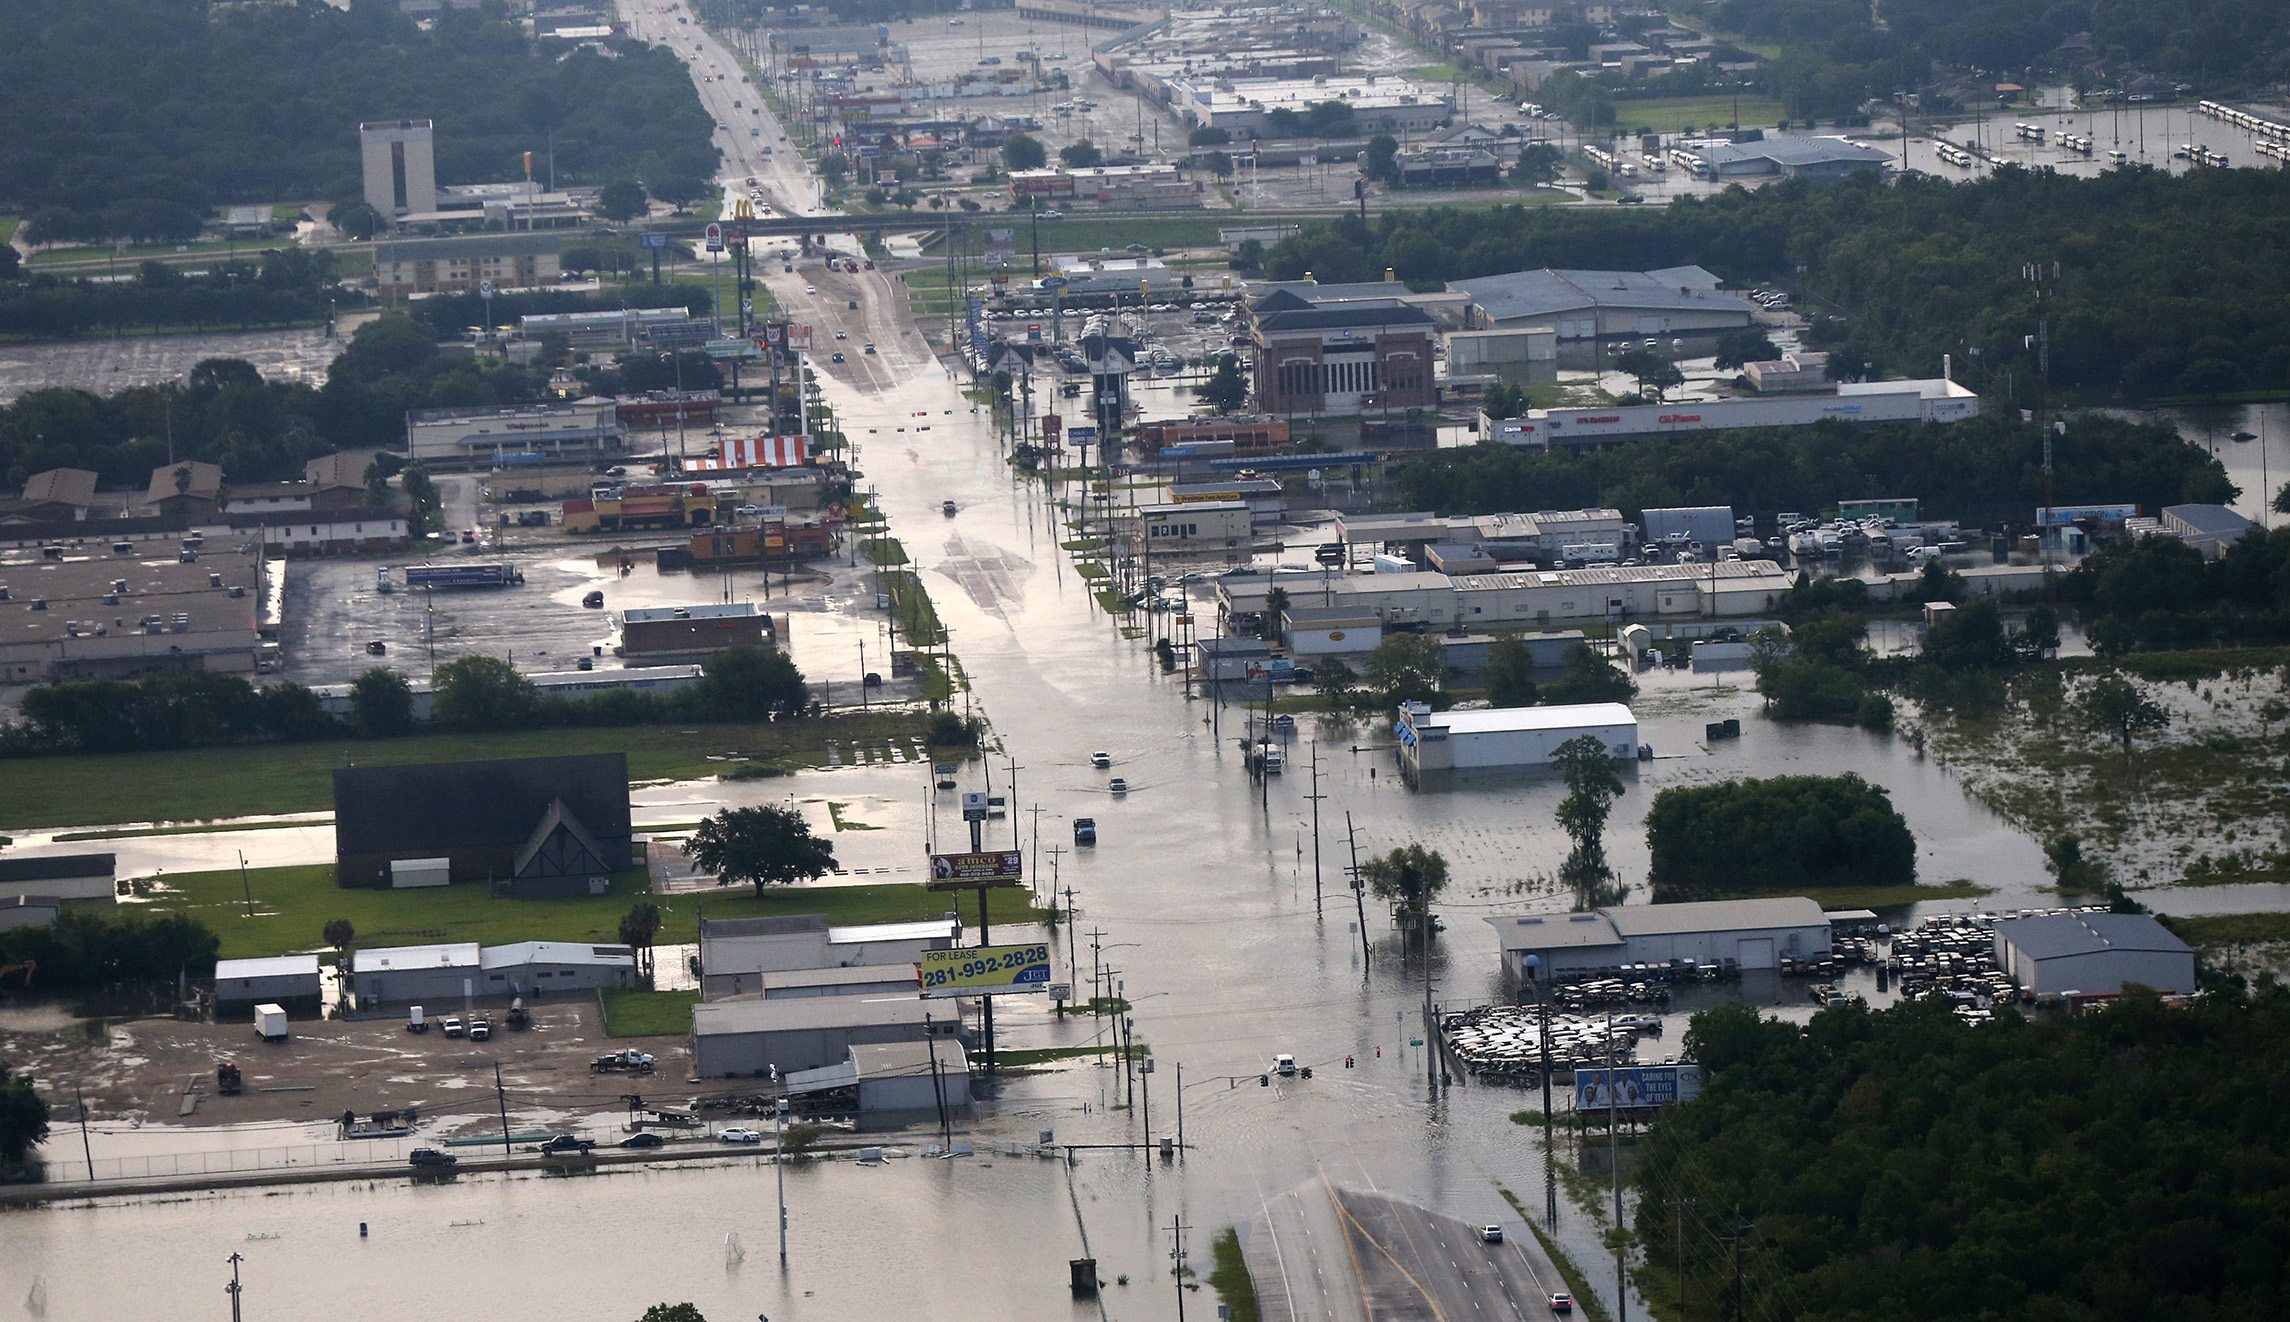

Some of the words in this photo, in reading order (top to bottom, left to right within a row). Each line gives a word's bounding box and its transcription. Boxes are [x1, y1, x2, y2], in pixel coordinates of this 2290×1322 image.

[957, 855, 996, 866] amco
[926, 951, 947, 962] FOR
[948, 949, 978, 961] LEASE
[923, 945, 1049, 988] 281-992-2828
[1641, 1071, 1663, 1082] CARING
[1664, 1071, 1676, 1081] FOR
[1645, 1083, 1658, 1092] THE
[1657, 1082, 1673, 1091] EYES
[1645, 1093, 1654, 1102] OF
[1654, 1092, 1673, 1102] TEXAS
